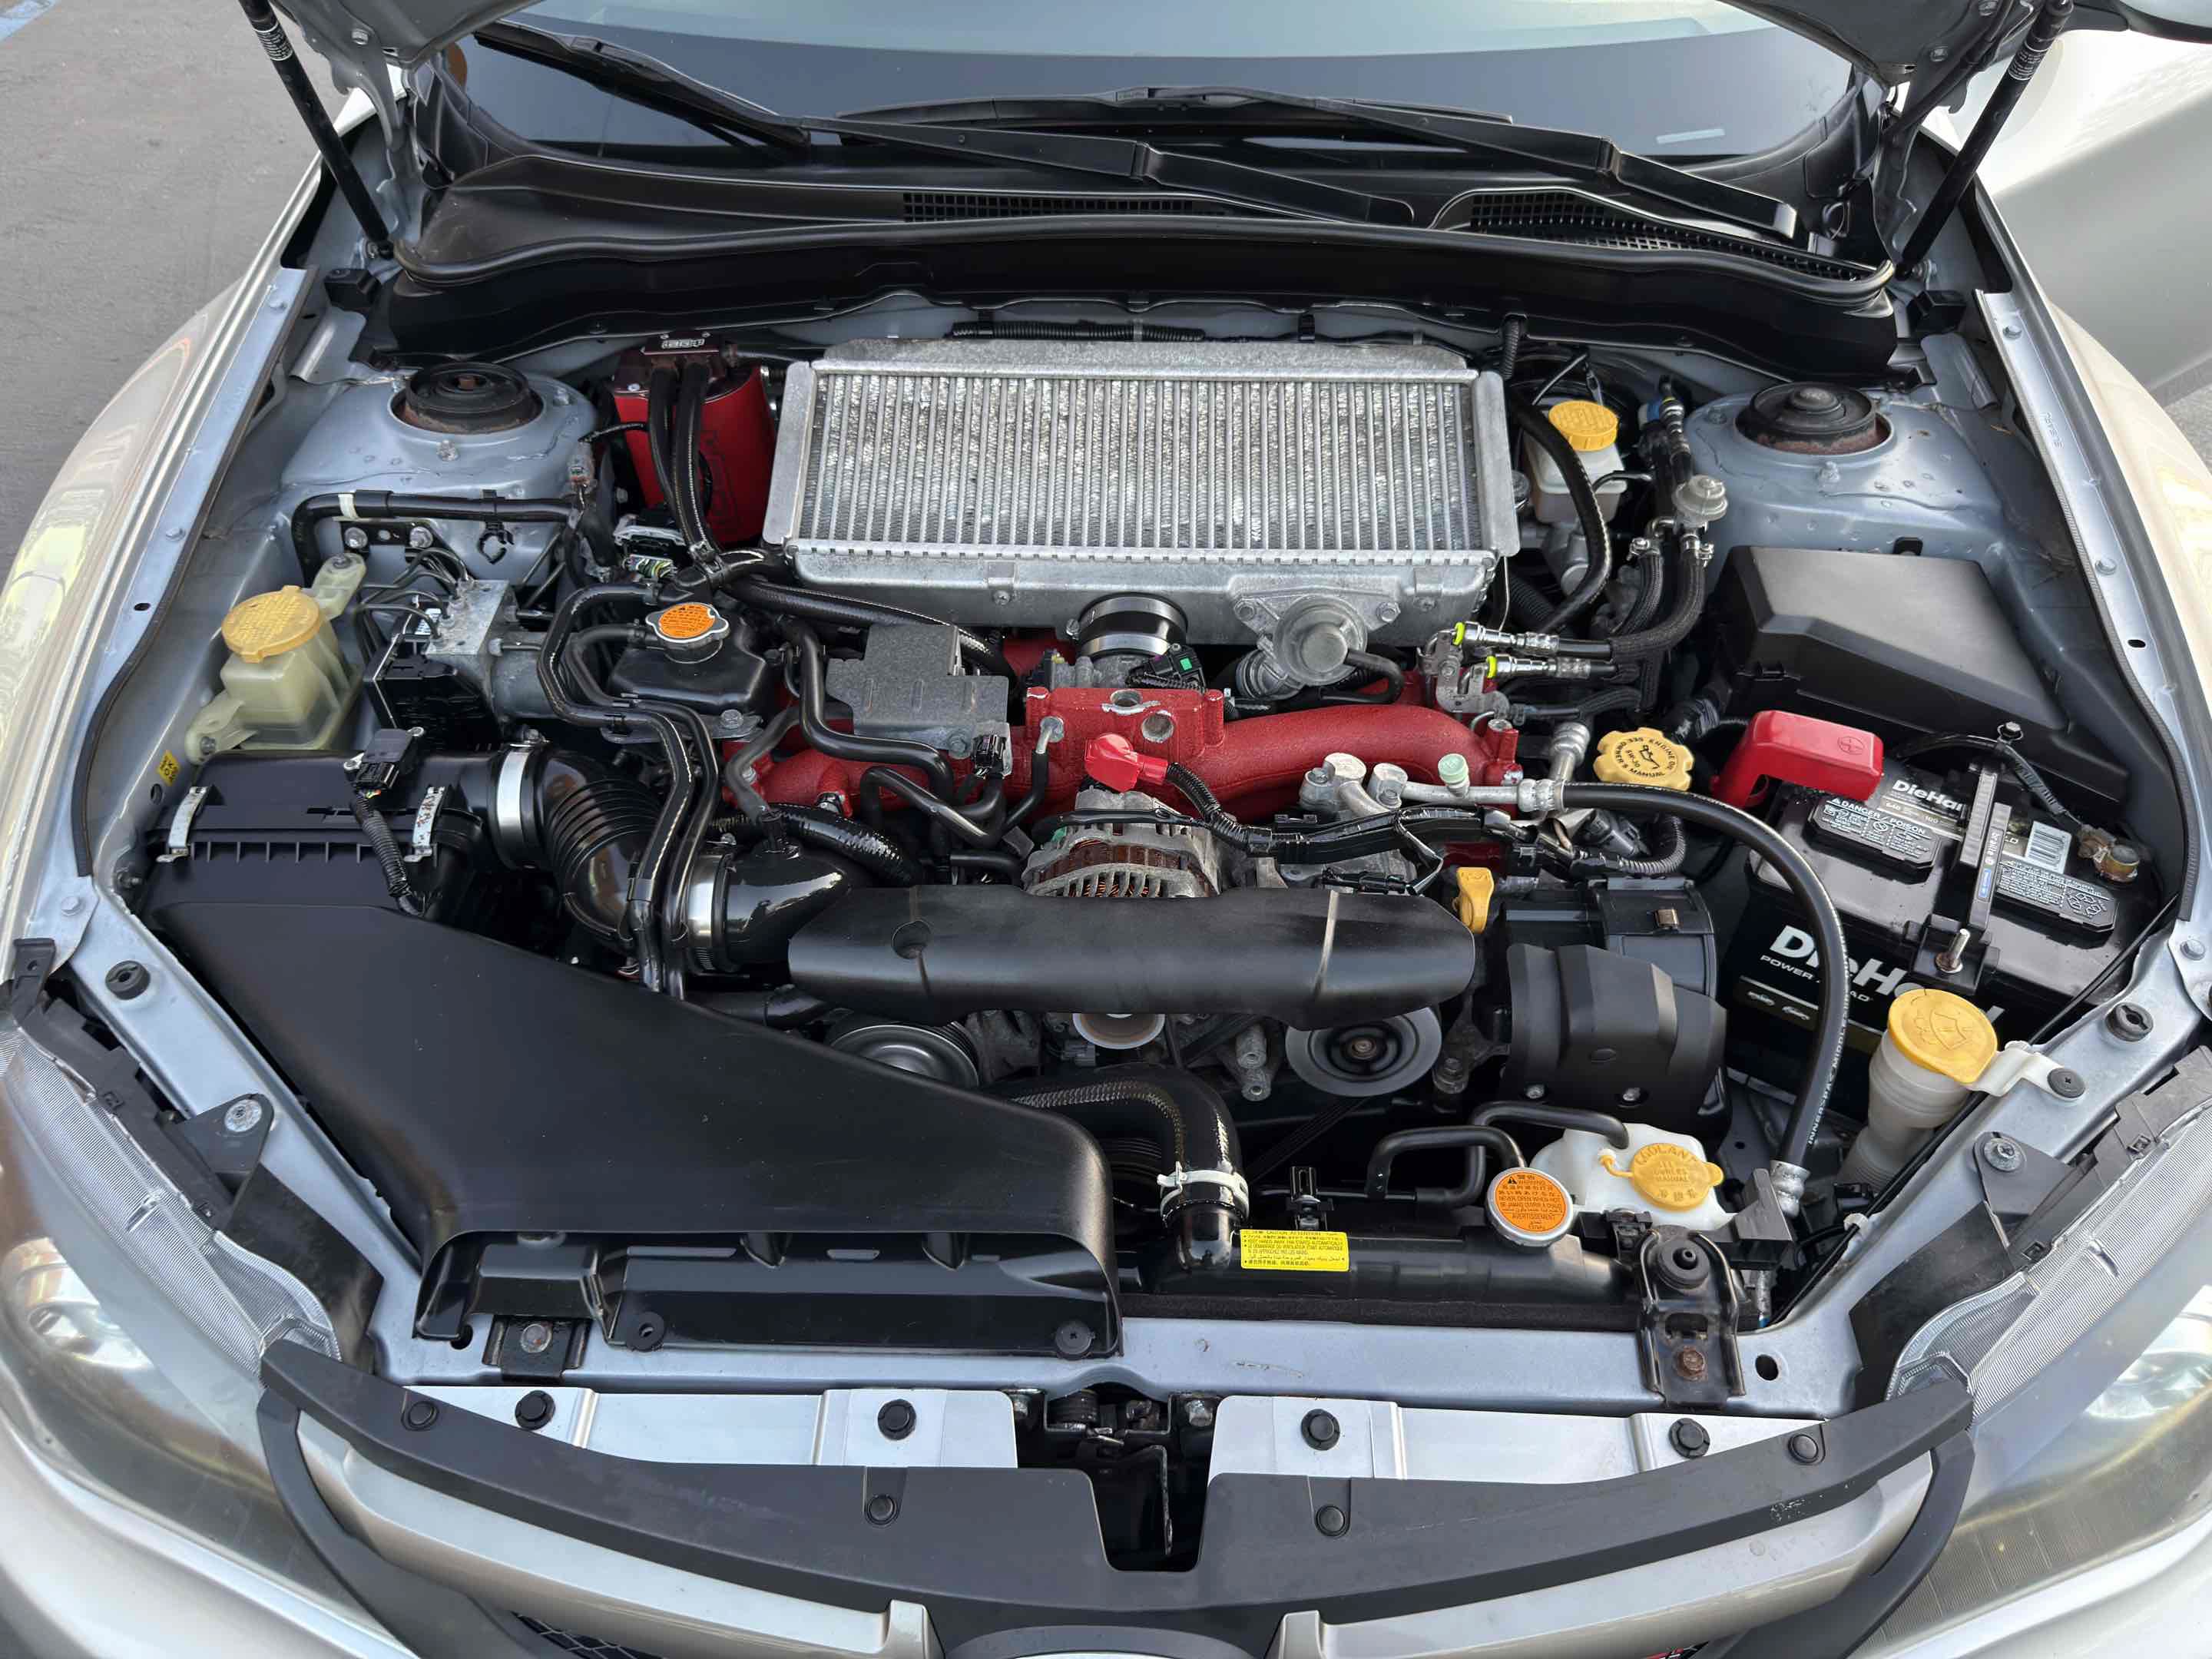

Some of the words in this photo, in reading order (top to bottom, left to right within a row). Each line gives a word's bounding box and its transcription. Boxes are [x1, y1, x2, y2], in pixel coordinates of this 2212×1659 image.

[1841, 801, 1881, 819] DANGER
[1889, 816, 1926, 835] POISON
[1760, 954, 1813, 980] POWER
